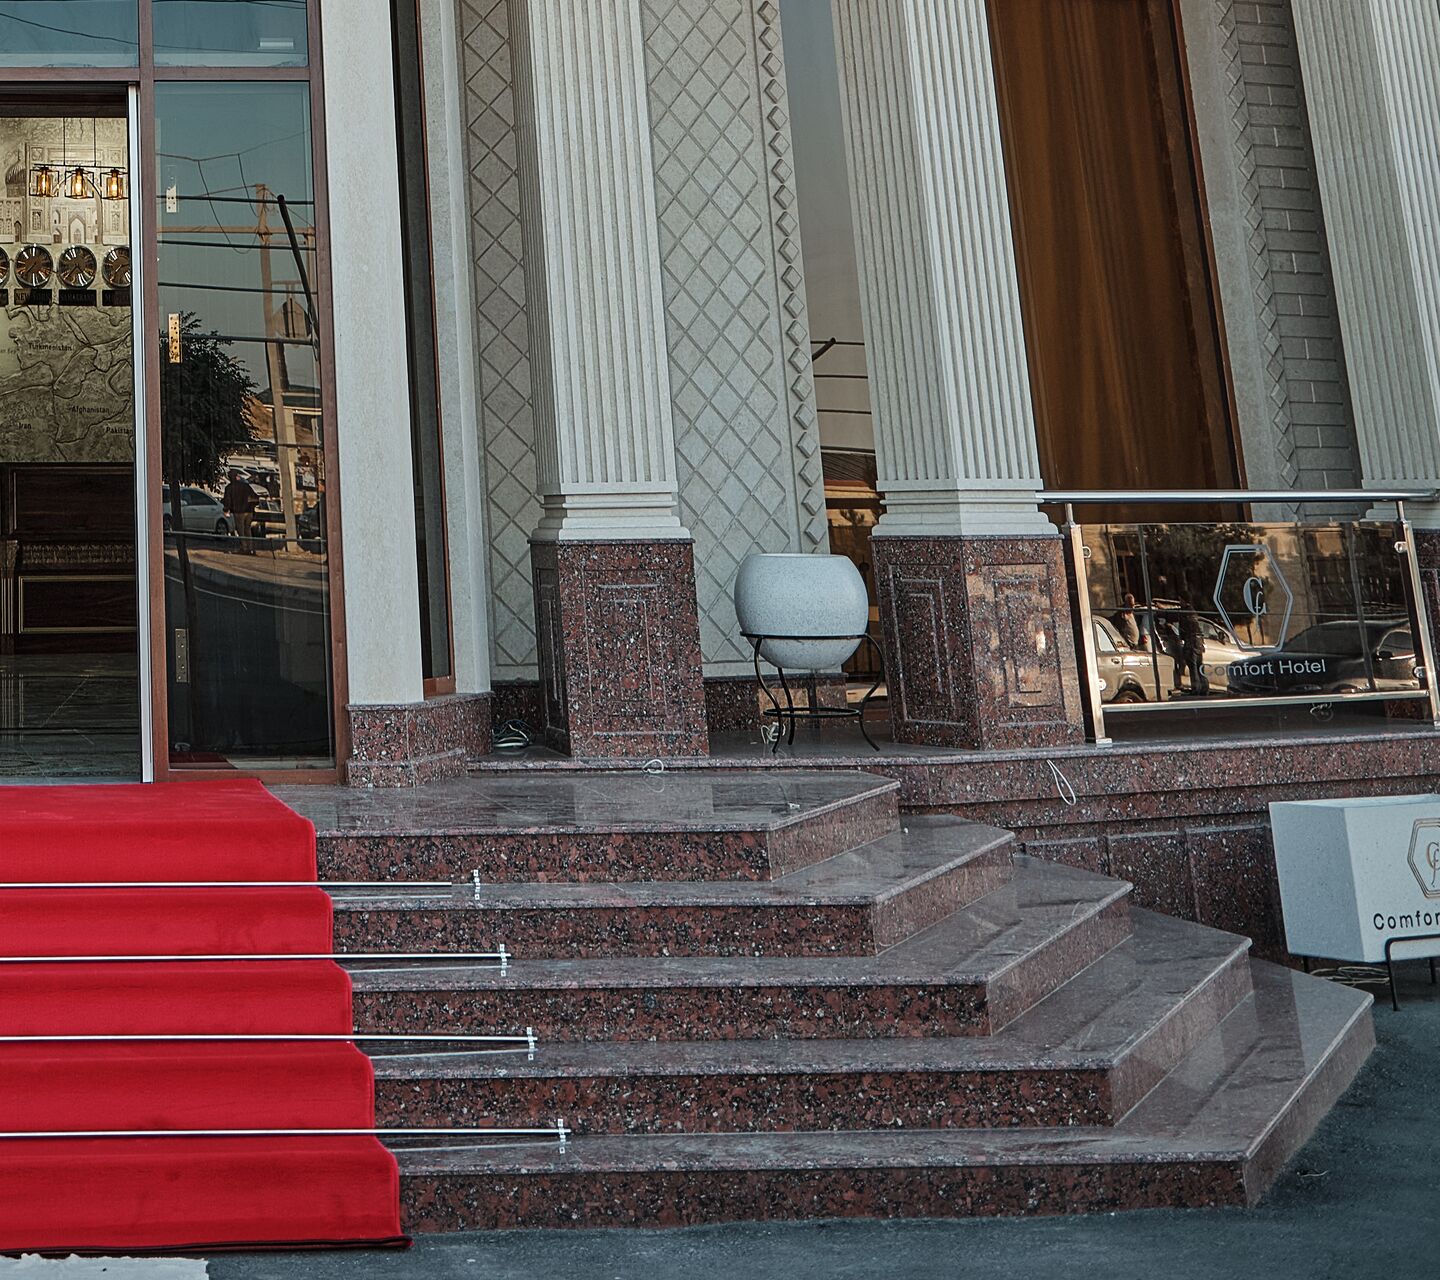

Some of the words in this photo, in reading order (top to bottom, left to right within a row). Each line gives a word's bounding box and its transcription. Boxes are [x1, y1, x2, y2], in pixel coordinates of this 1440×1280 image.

[28, 342, 74, 352] Turkmenistan
[71, 405, 110, 414] Afghanistan
[18, 422, 32, 430] Iran
[1199, 661, 1274, 677] Comfort
[1279, 659, 1326, 675] Hotel
[1373, 910, 1440, 930] Comfor
